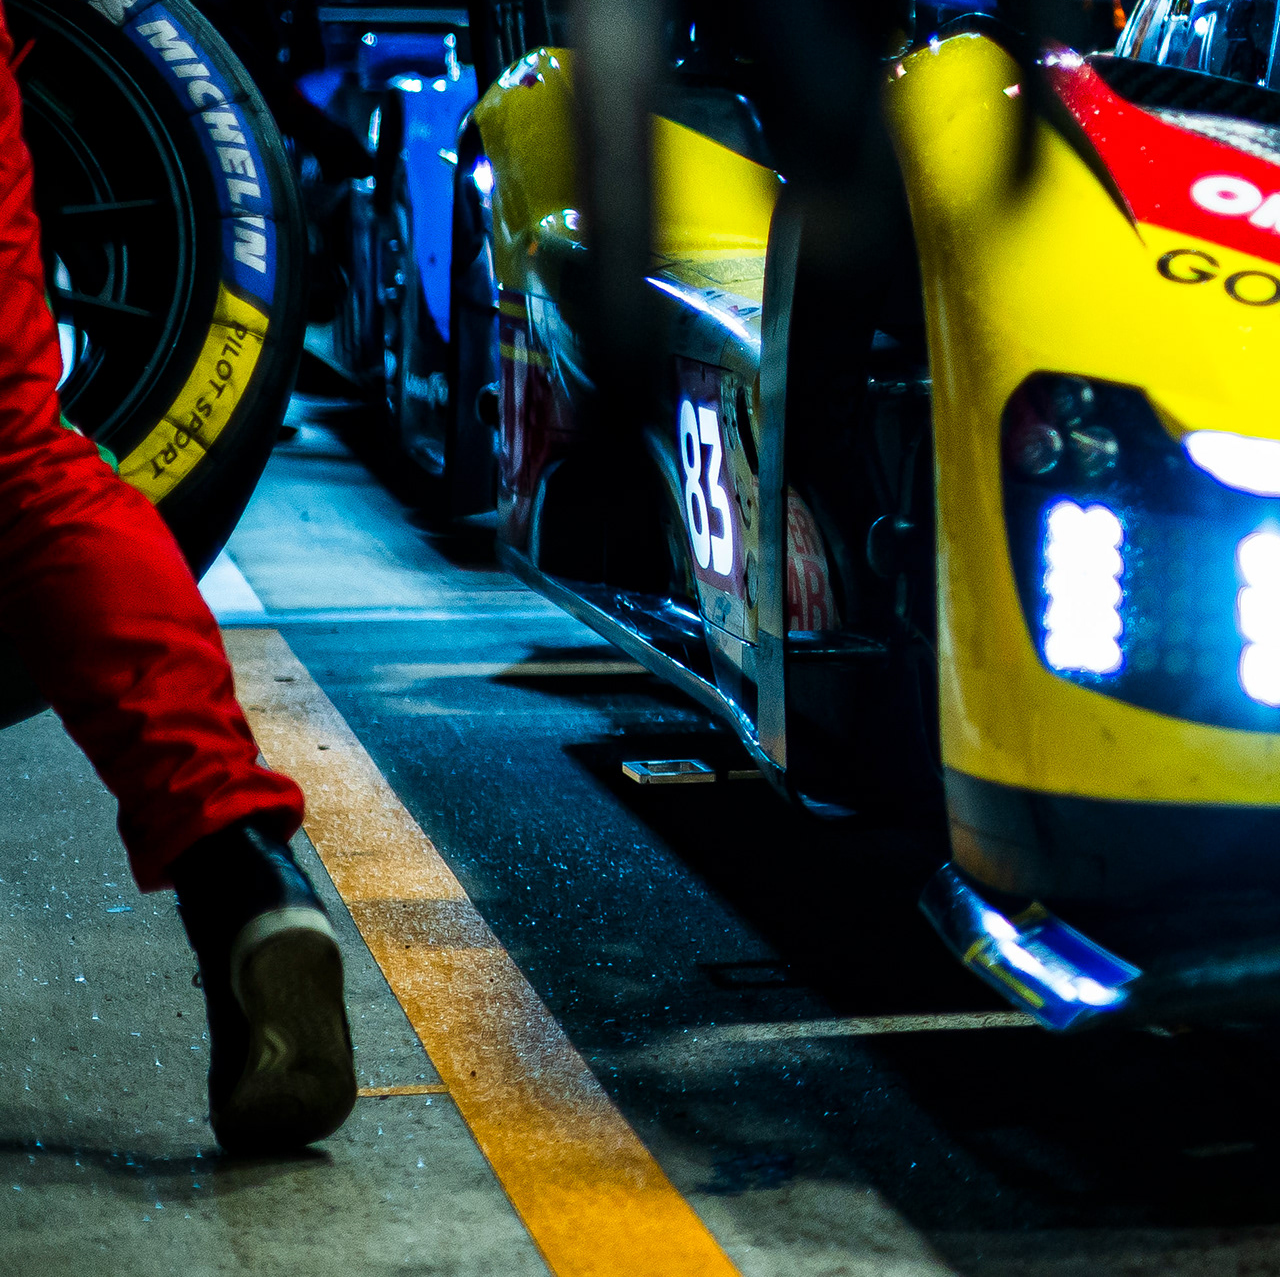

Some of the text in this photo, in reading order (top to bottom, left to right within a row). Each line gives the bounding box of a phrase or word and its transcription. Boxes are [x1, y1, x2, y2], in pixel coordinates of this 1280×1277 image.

[135, 18, 267, 275] MICHELIN
[152, 322, 249, 482] PILOT SPORT
[680, 399, 734, 577] 83
